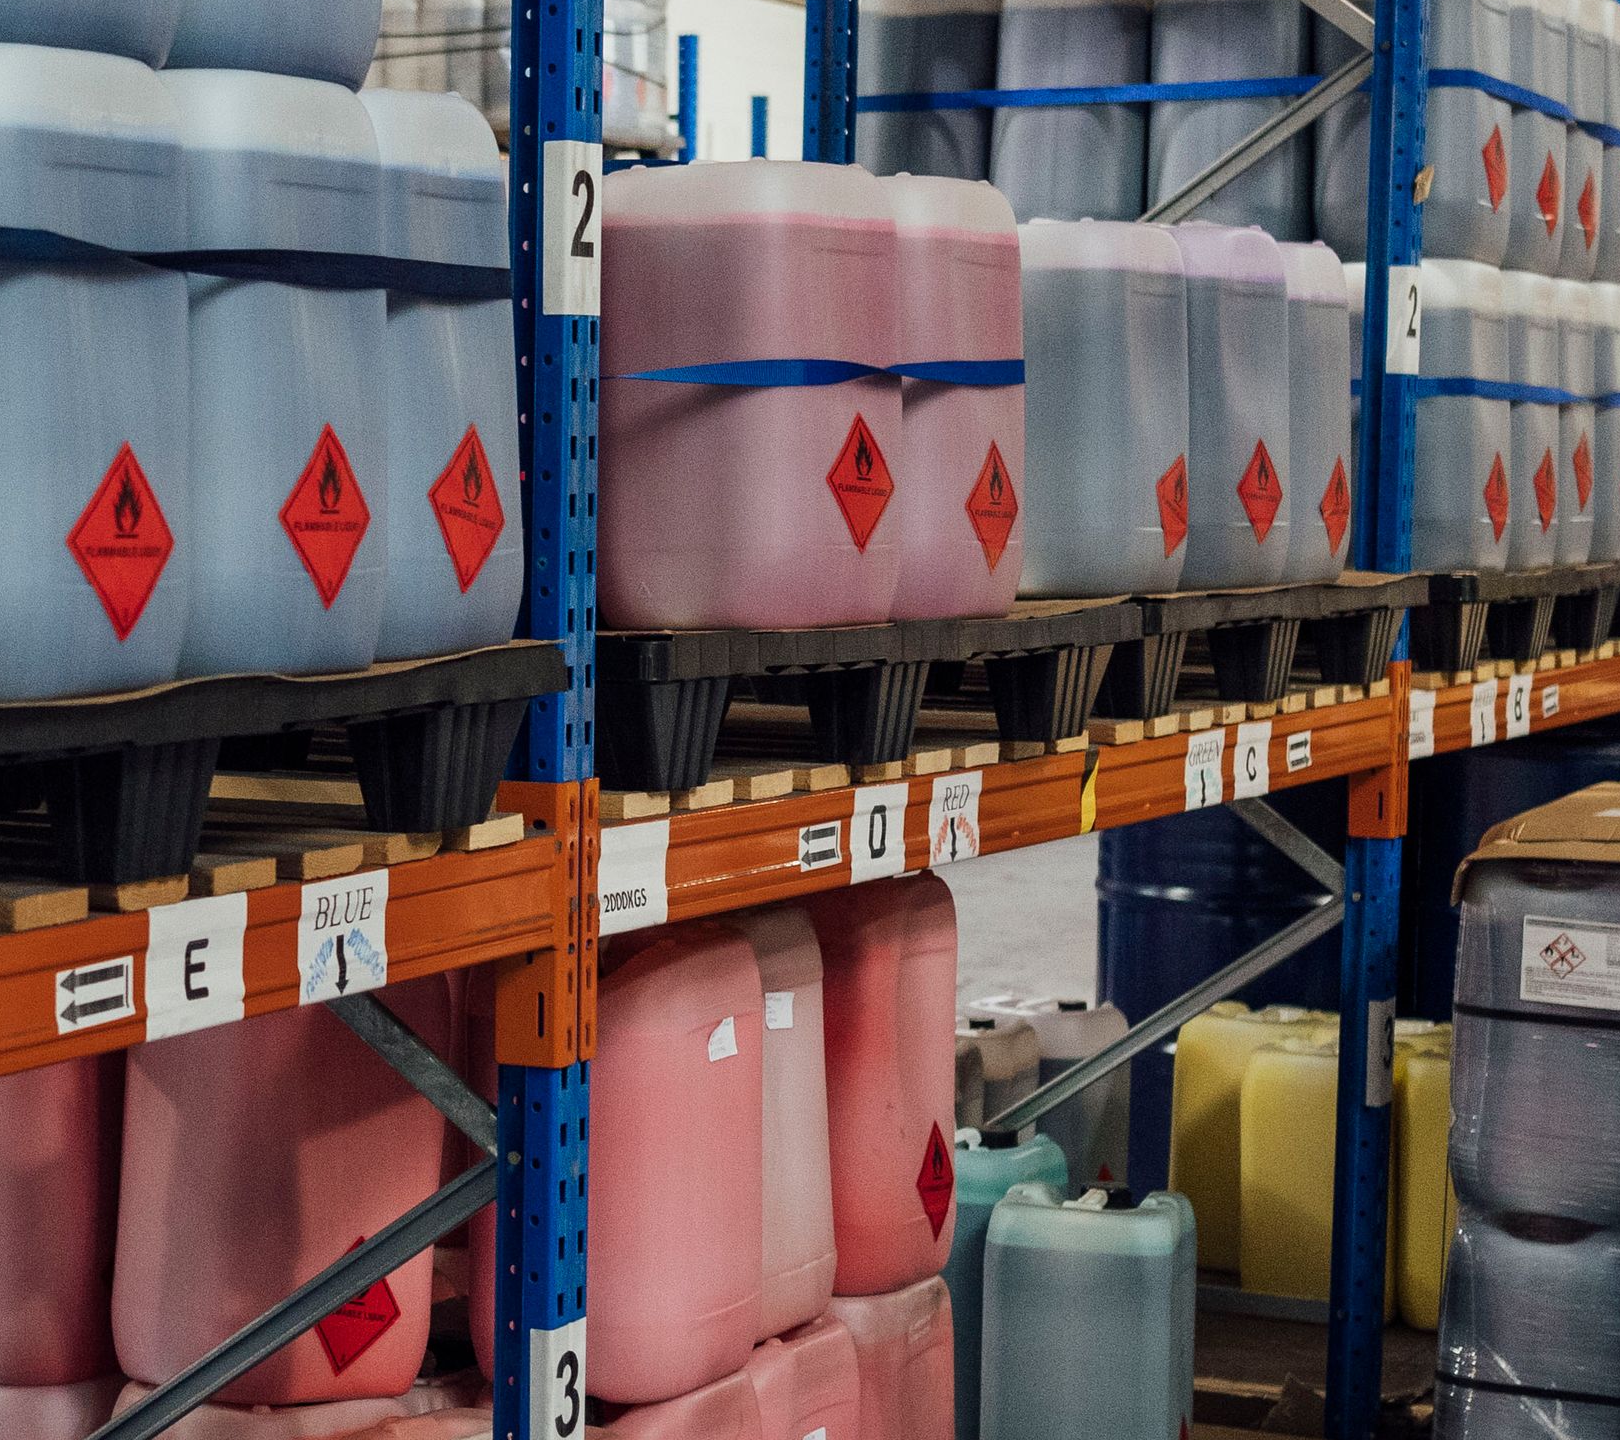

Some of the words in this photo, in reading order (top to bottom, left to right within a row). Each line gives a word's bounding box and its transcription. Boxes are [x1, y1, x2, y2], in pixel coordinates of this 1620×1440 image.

[570, 169, 595, 258] 2
[1406, 285, 1417, 339] 2
[1189, 739, 1221, 767] GREEN
[1246, 746, 1257, 782] C
[942, 784, 970, 812] RED
[314, 886, 374, 931] BLUE
[603, 888, 647, 913] 2000KGS
[184, 938, 210, 1001] E
[554, 1350, 580, 1439] 3
